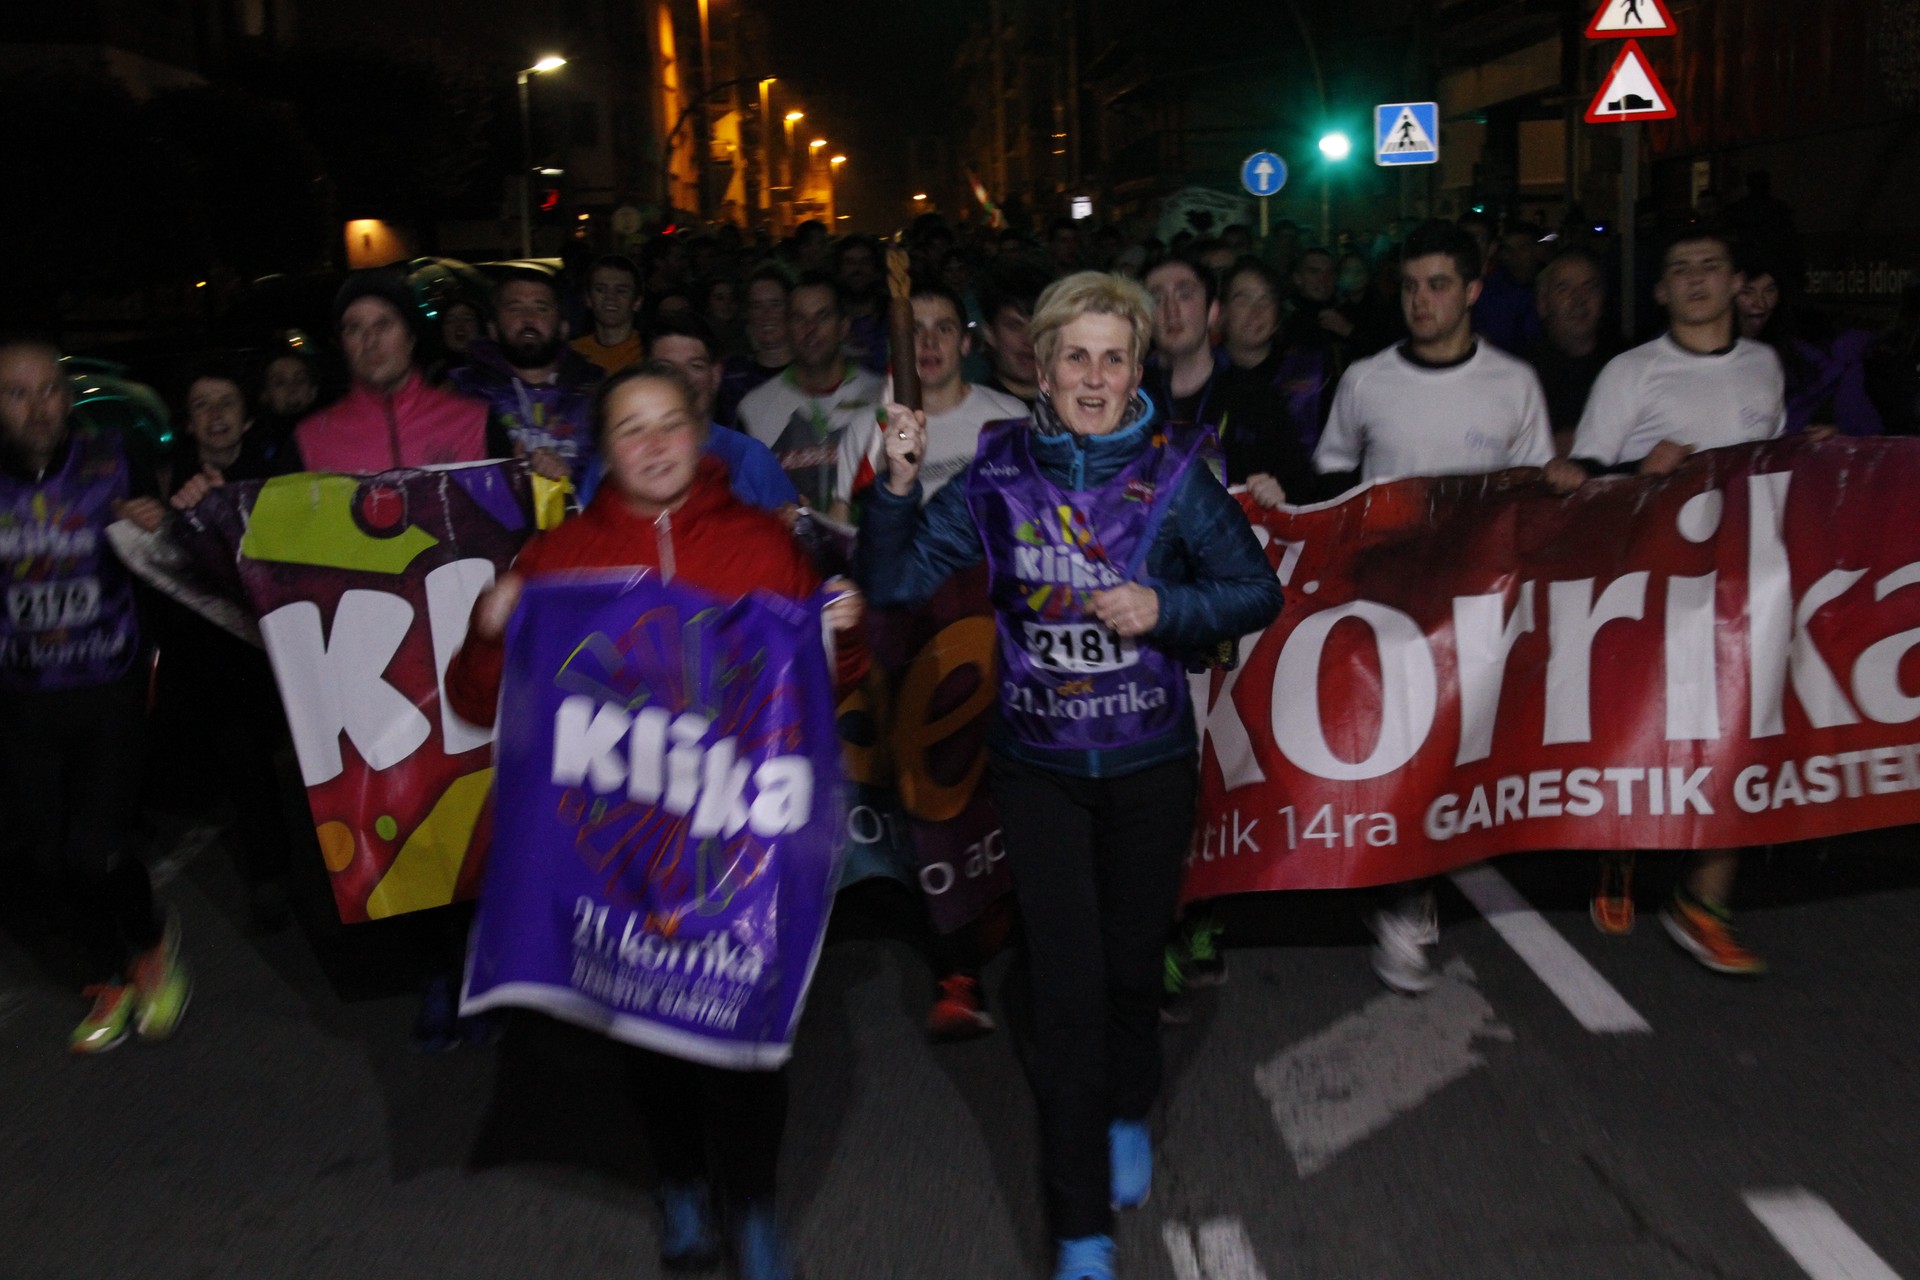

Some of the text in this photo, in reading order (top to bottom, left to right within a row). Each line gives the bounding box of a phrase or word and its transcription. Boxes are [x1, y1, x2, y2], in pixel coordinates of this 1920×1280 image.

[1035, 629, 1122, 666] 2181
[1278, 803, 1398, 850] 14ra
[1423, 767, 1715, 841] GARESTIK
